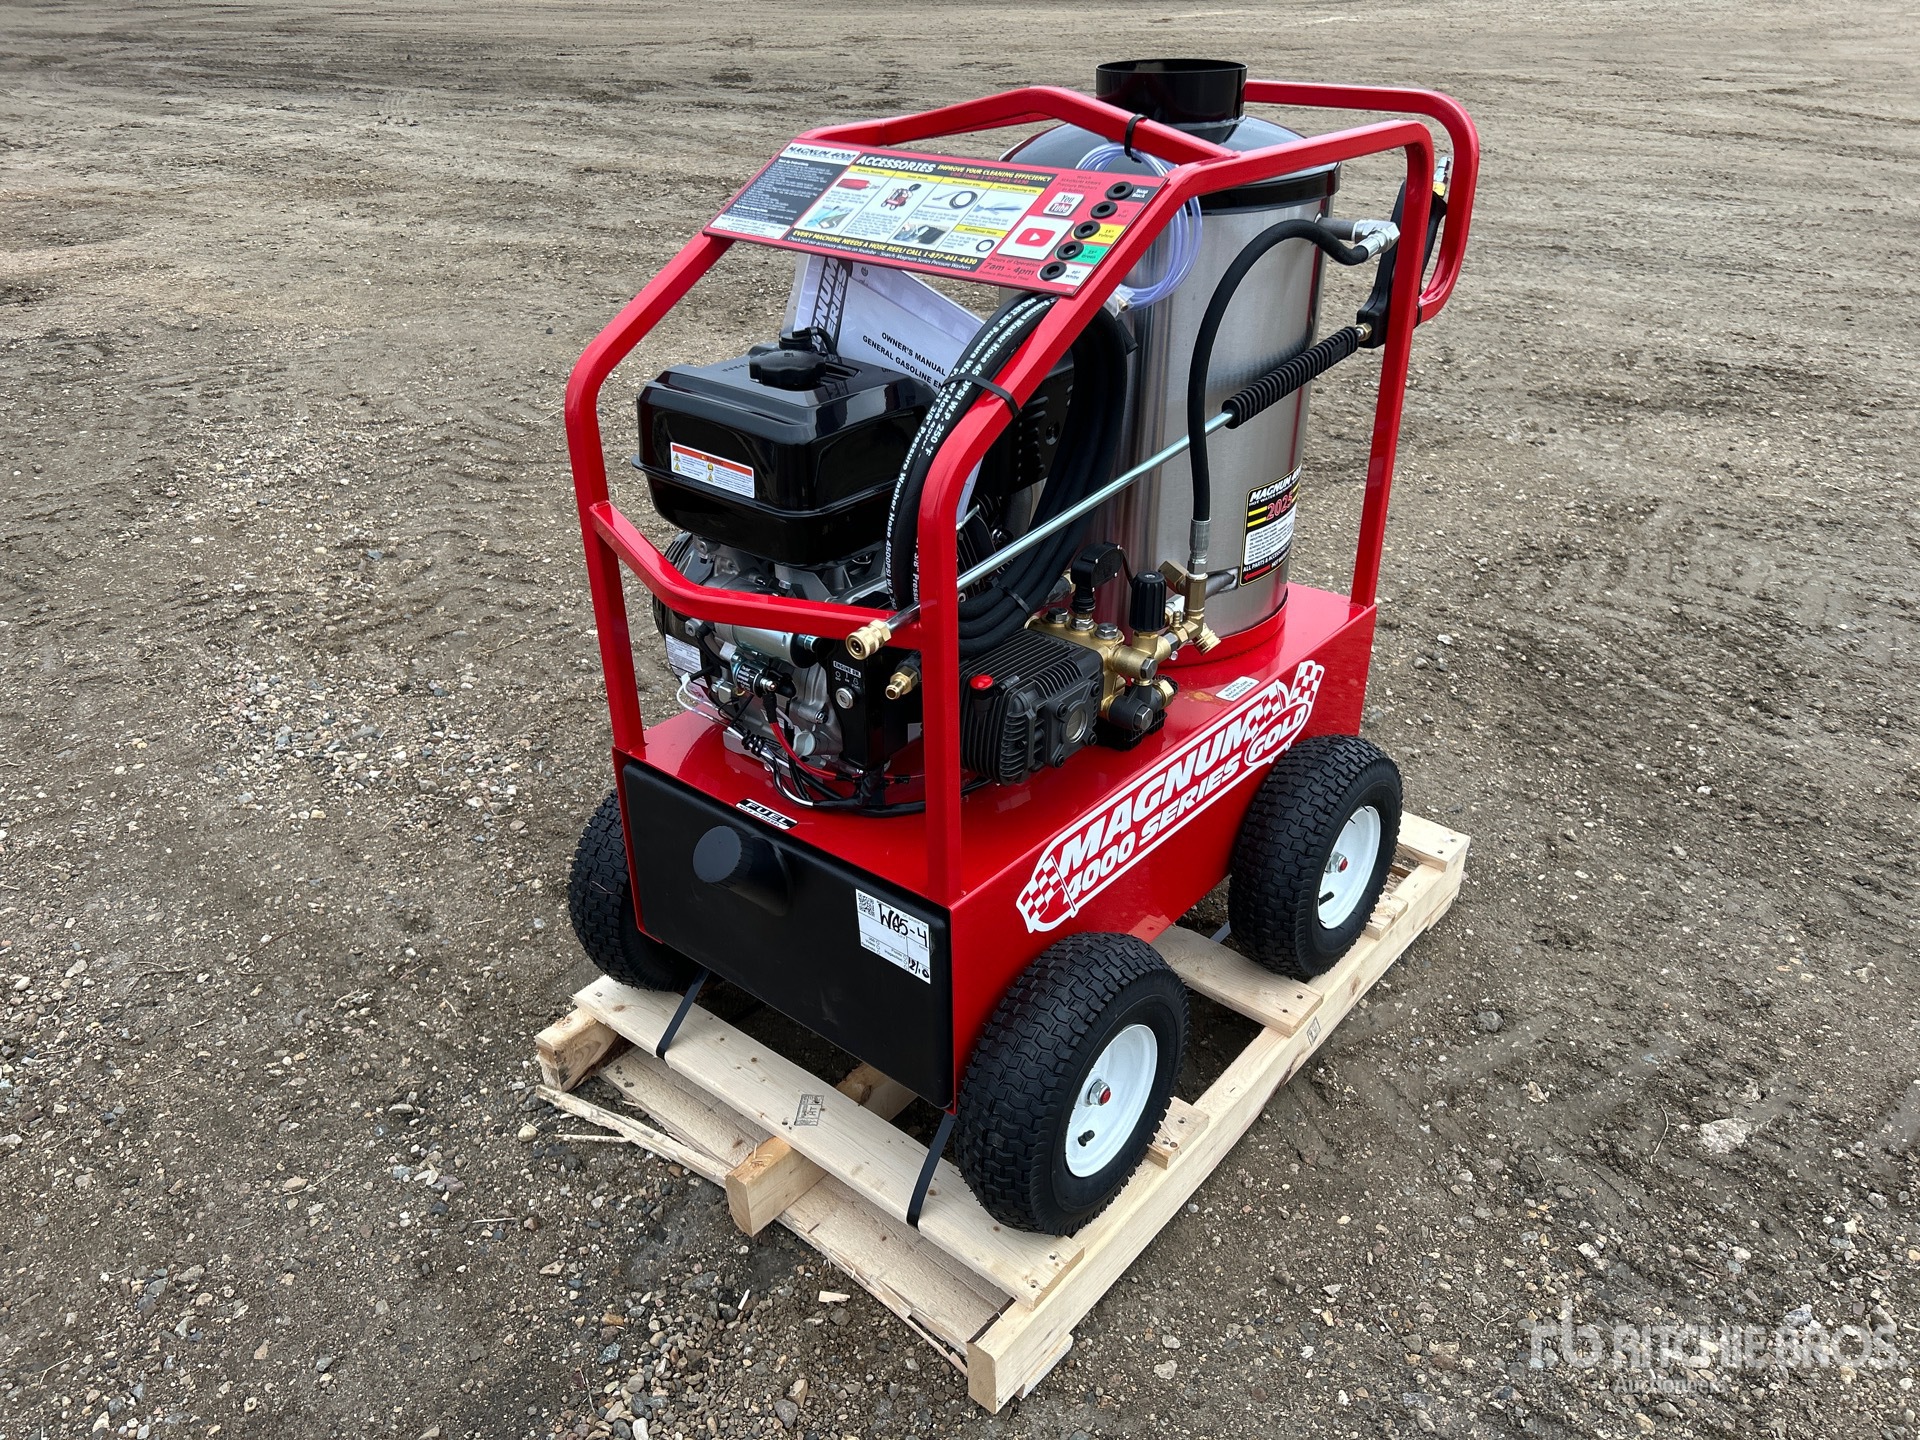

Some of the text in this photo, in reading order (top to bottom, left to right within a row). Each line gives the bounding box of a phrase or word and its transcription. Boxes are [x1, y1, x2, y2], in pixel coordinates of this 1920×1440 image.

[857, 156, 936, 173] ACCESSORIES
[938, 164, 964, 172] IMPROVE
[982, 169, 1014, 178] CLEANING
[1014, 172, 1052, 182] EFFICIENCY
[1052, 204, 1070, 212] Tube
[1062, 195, 1075, 203] You
[793, 230, 813, 238] EVERY
[813, 233, 842, 243] MACHINE
[842, 238, 863, 247] NEEDS
[869, 242, 887, 251] HOSE
[887, 244, 905, 253] REEL!
[905, 248, 922, 257] CALL
[923, 251, 978, 265] 1-877-441-4430
[951, 262, 970, 270] Washers
[984, 262, 1005, 272] 7am
[1013, 267, 1035, 276] 4pm
[1013, 260, 1040, 268] Operation
[825, 264, 847, 342] ERIES
[970, 326, 1000, 359] Pressure
[998, 318, 1024, 344] Washer
[882, 332, 913, 356] OWNER'S
[980, 342, 1000, 364] Hose
[862, 335, 942, 389] GENERAL GASOLINE EN
[914, 352, 946, 376] MANUAL
[934, 394, 952, 420] Hose
[930, 424, 945, 444] 250
[902, 426, 927, 470] Pressure
[893, 472, 906, 514] Washer
[1250, 474, 1292, 503] MAGNUM
[1266, 490, 1293, 520] 2025
[886, 514, 896, 538] Hose
[1242, 563, 1252, 572] ALL
[1252, 558, 1264, 570] PARTS
[1251, 704, 1304, 761] GOLD
[1057, 704, 1266, 879] MAGNUM
[746, 802, 788, 826] FUEL
[1064, 751, 1243, 902] 4000 SERIES
